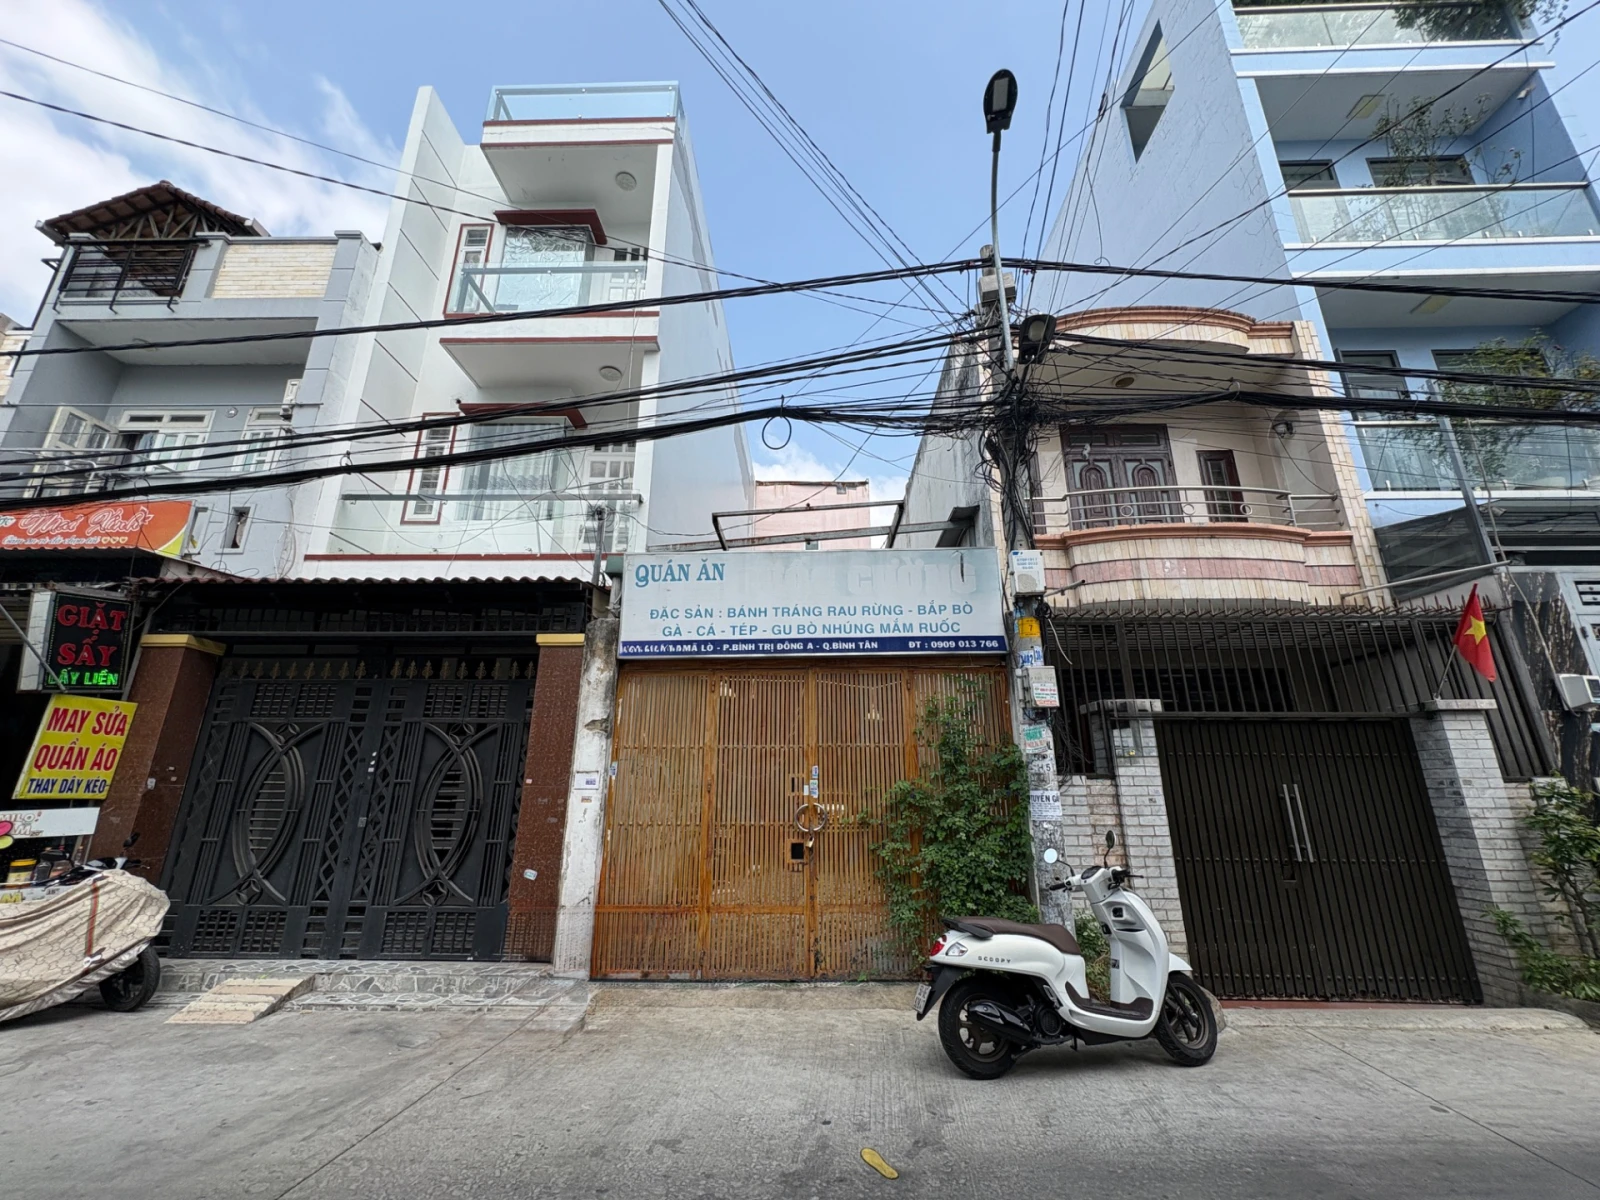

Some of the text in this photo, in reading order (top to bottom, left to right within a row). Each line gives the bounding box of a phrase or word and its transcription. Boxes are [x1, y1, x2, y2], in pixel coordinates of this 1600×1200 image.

[635, 559, 691, 588] QUÁN
[696, 558, 726, 582] ĂN
[649, 606, 680, 622] ĐẶC
[684, 604, 714, 619] SẢN
[727, 604, 768, 619] BÁNH
[772, 603, 823, 618] TRÁNG
[827, 605, 857, 617] RAU
[861, 602, 904, 617] RỪNG
[917, 600, 947, 616] BẮP
[952, 601, 973, 615] BÒ
[662, 623, 683, 637] GÀ
[696, 622, 716, 637] CÁ
[730, 622, 758, 636] TÉP
[771, 624, 793, 636] GU
[797, 621, 817, 635] BÒ
[822, 620, 875, 635] NHÚNG
[879, 617, 914, 634] MẮM
[919, 617, 961, 634] RUỐC
[57, 635, 117, 666] SẤY
[701, 642, 714, 652] LÒ
[723, 641, 756, 651] P.BÌNH
[758, 642, 774, 652] TRỊ
[776, 640, 804, 651] ĐÔNG
[807, 642, 815, 650] A
[822, 640, 856, 650] Q.BÌNH
[858, 640, 879, 649] TÂN
[908, 641, 922, 649] ĐT
[931, 641, 956, 649] 0909
[958, 640, 977, 648] 013
[980, 640, 999, 648] 766
[46, 705, 128, 737] MAY SỬA
[33, 737, 118, 773] QUẦN ÁO
[27, 775, 107, 794] THAY DÂY KÉO
[977, 955, 1011, 964] SCOOPY
